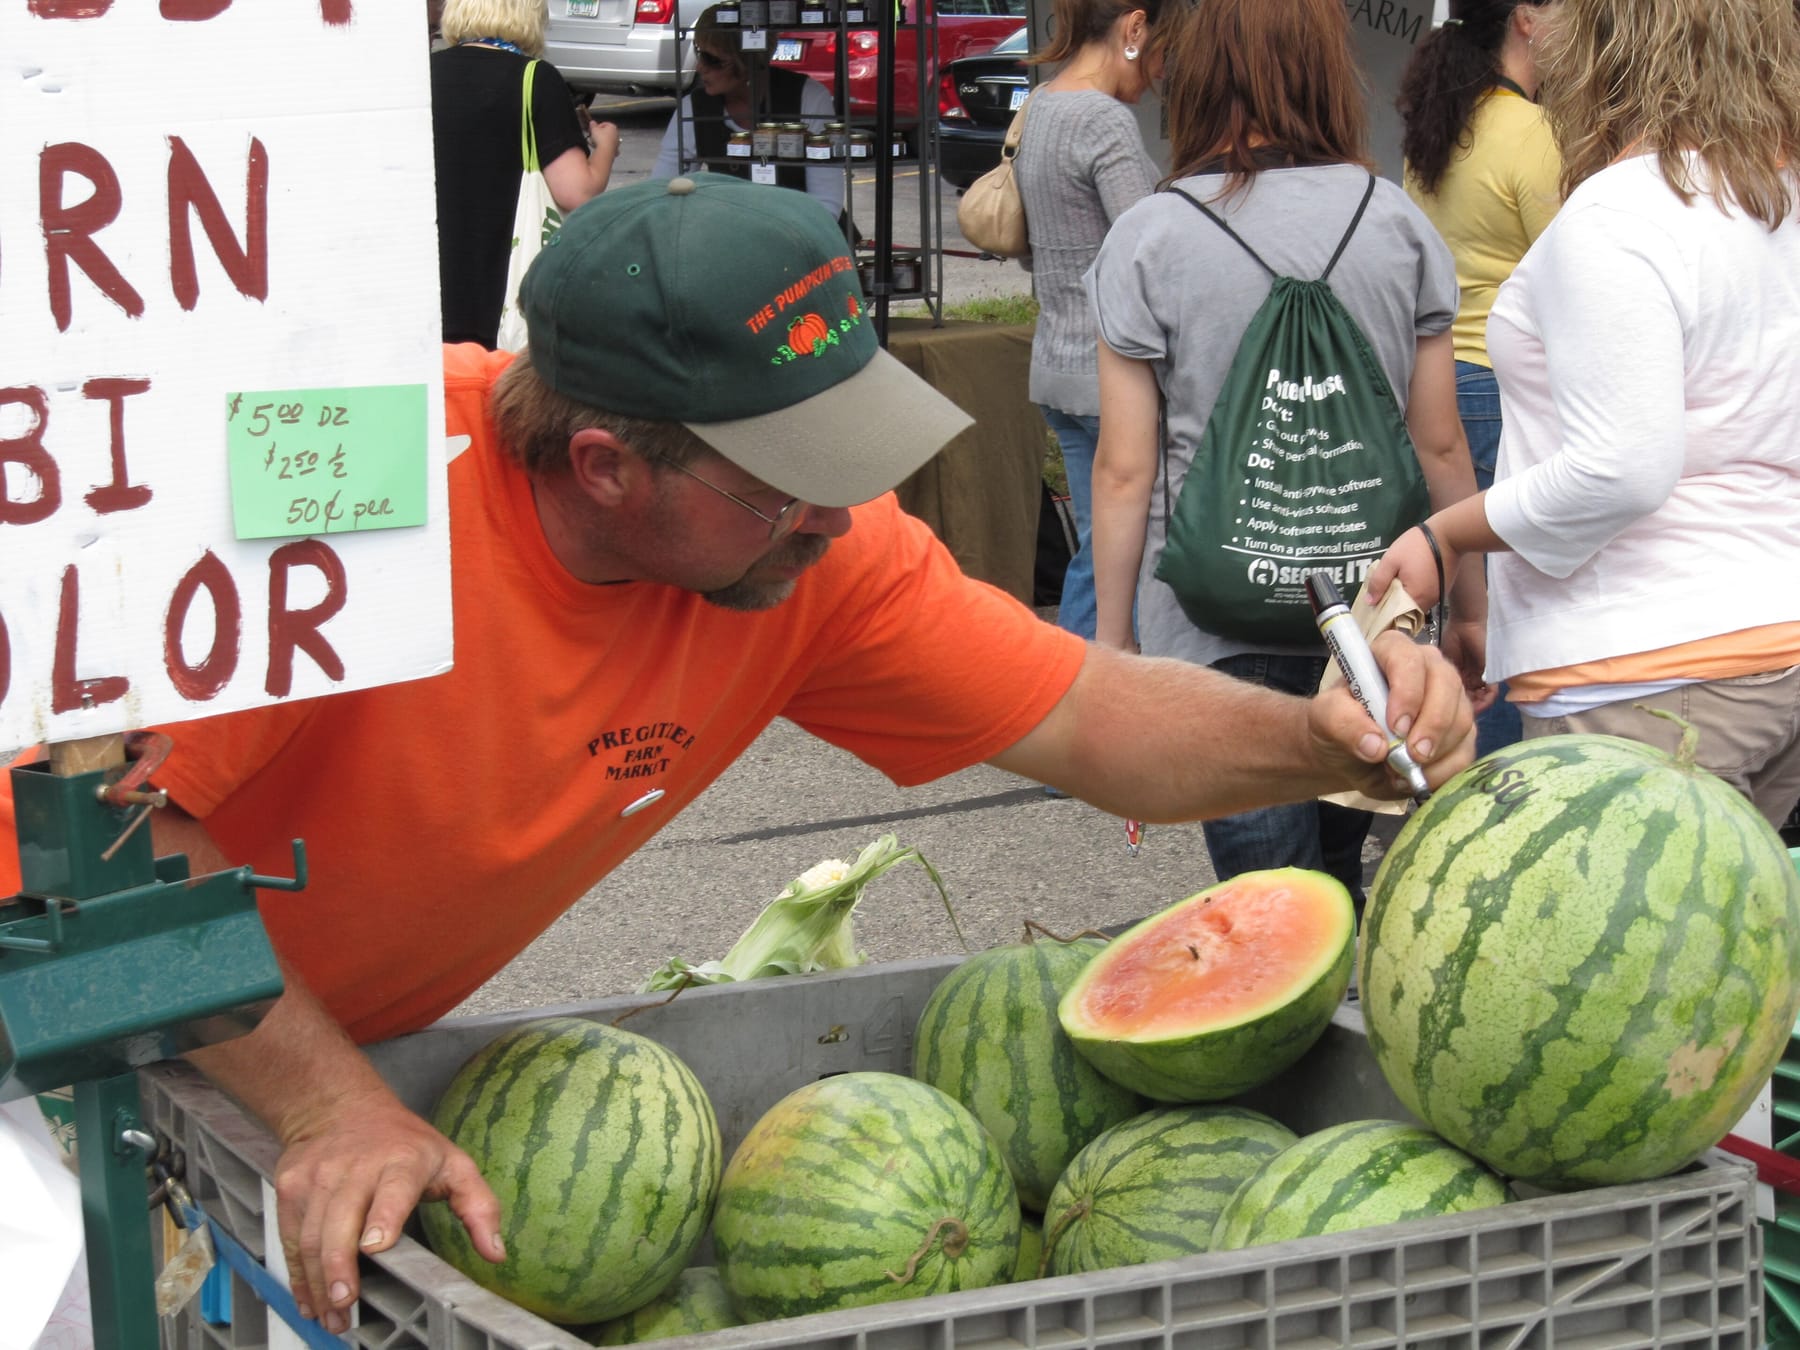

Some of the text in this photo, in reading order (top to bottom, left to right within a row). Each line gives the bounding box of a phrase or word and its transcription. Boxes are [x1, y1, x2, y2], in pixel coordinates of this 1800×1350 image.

[746, 303, 776, 335] THE
[775, 263, 833, 313] PUMPKIN
[1280, 431, 1299, 443] out
[0, 374, 153, 526] BI
[1248, 453, 1276, 472] Do:
[1338, 477, 1383, 495] software
[1251, 497, 1272, 511] Use
[1246, 517, 1280, 534] Apply
[1324, 521, 1367, 536] updates
[1243, 536, 1382, 557] Turn on a personal firewall
[1345, 558, 1373, 584] IT
[0, 537, 348, 715] LOR
